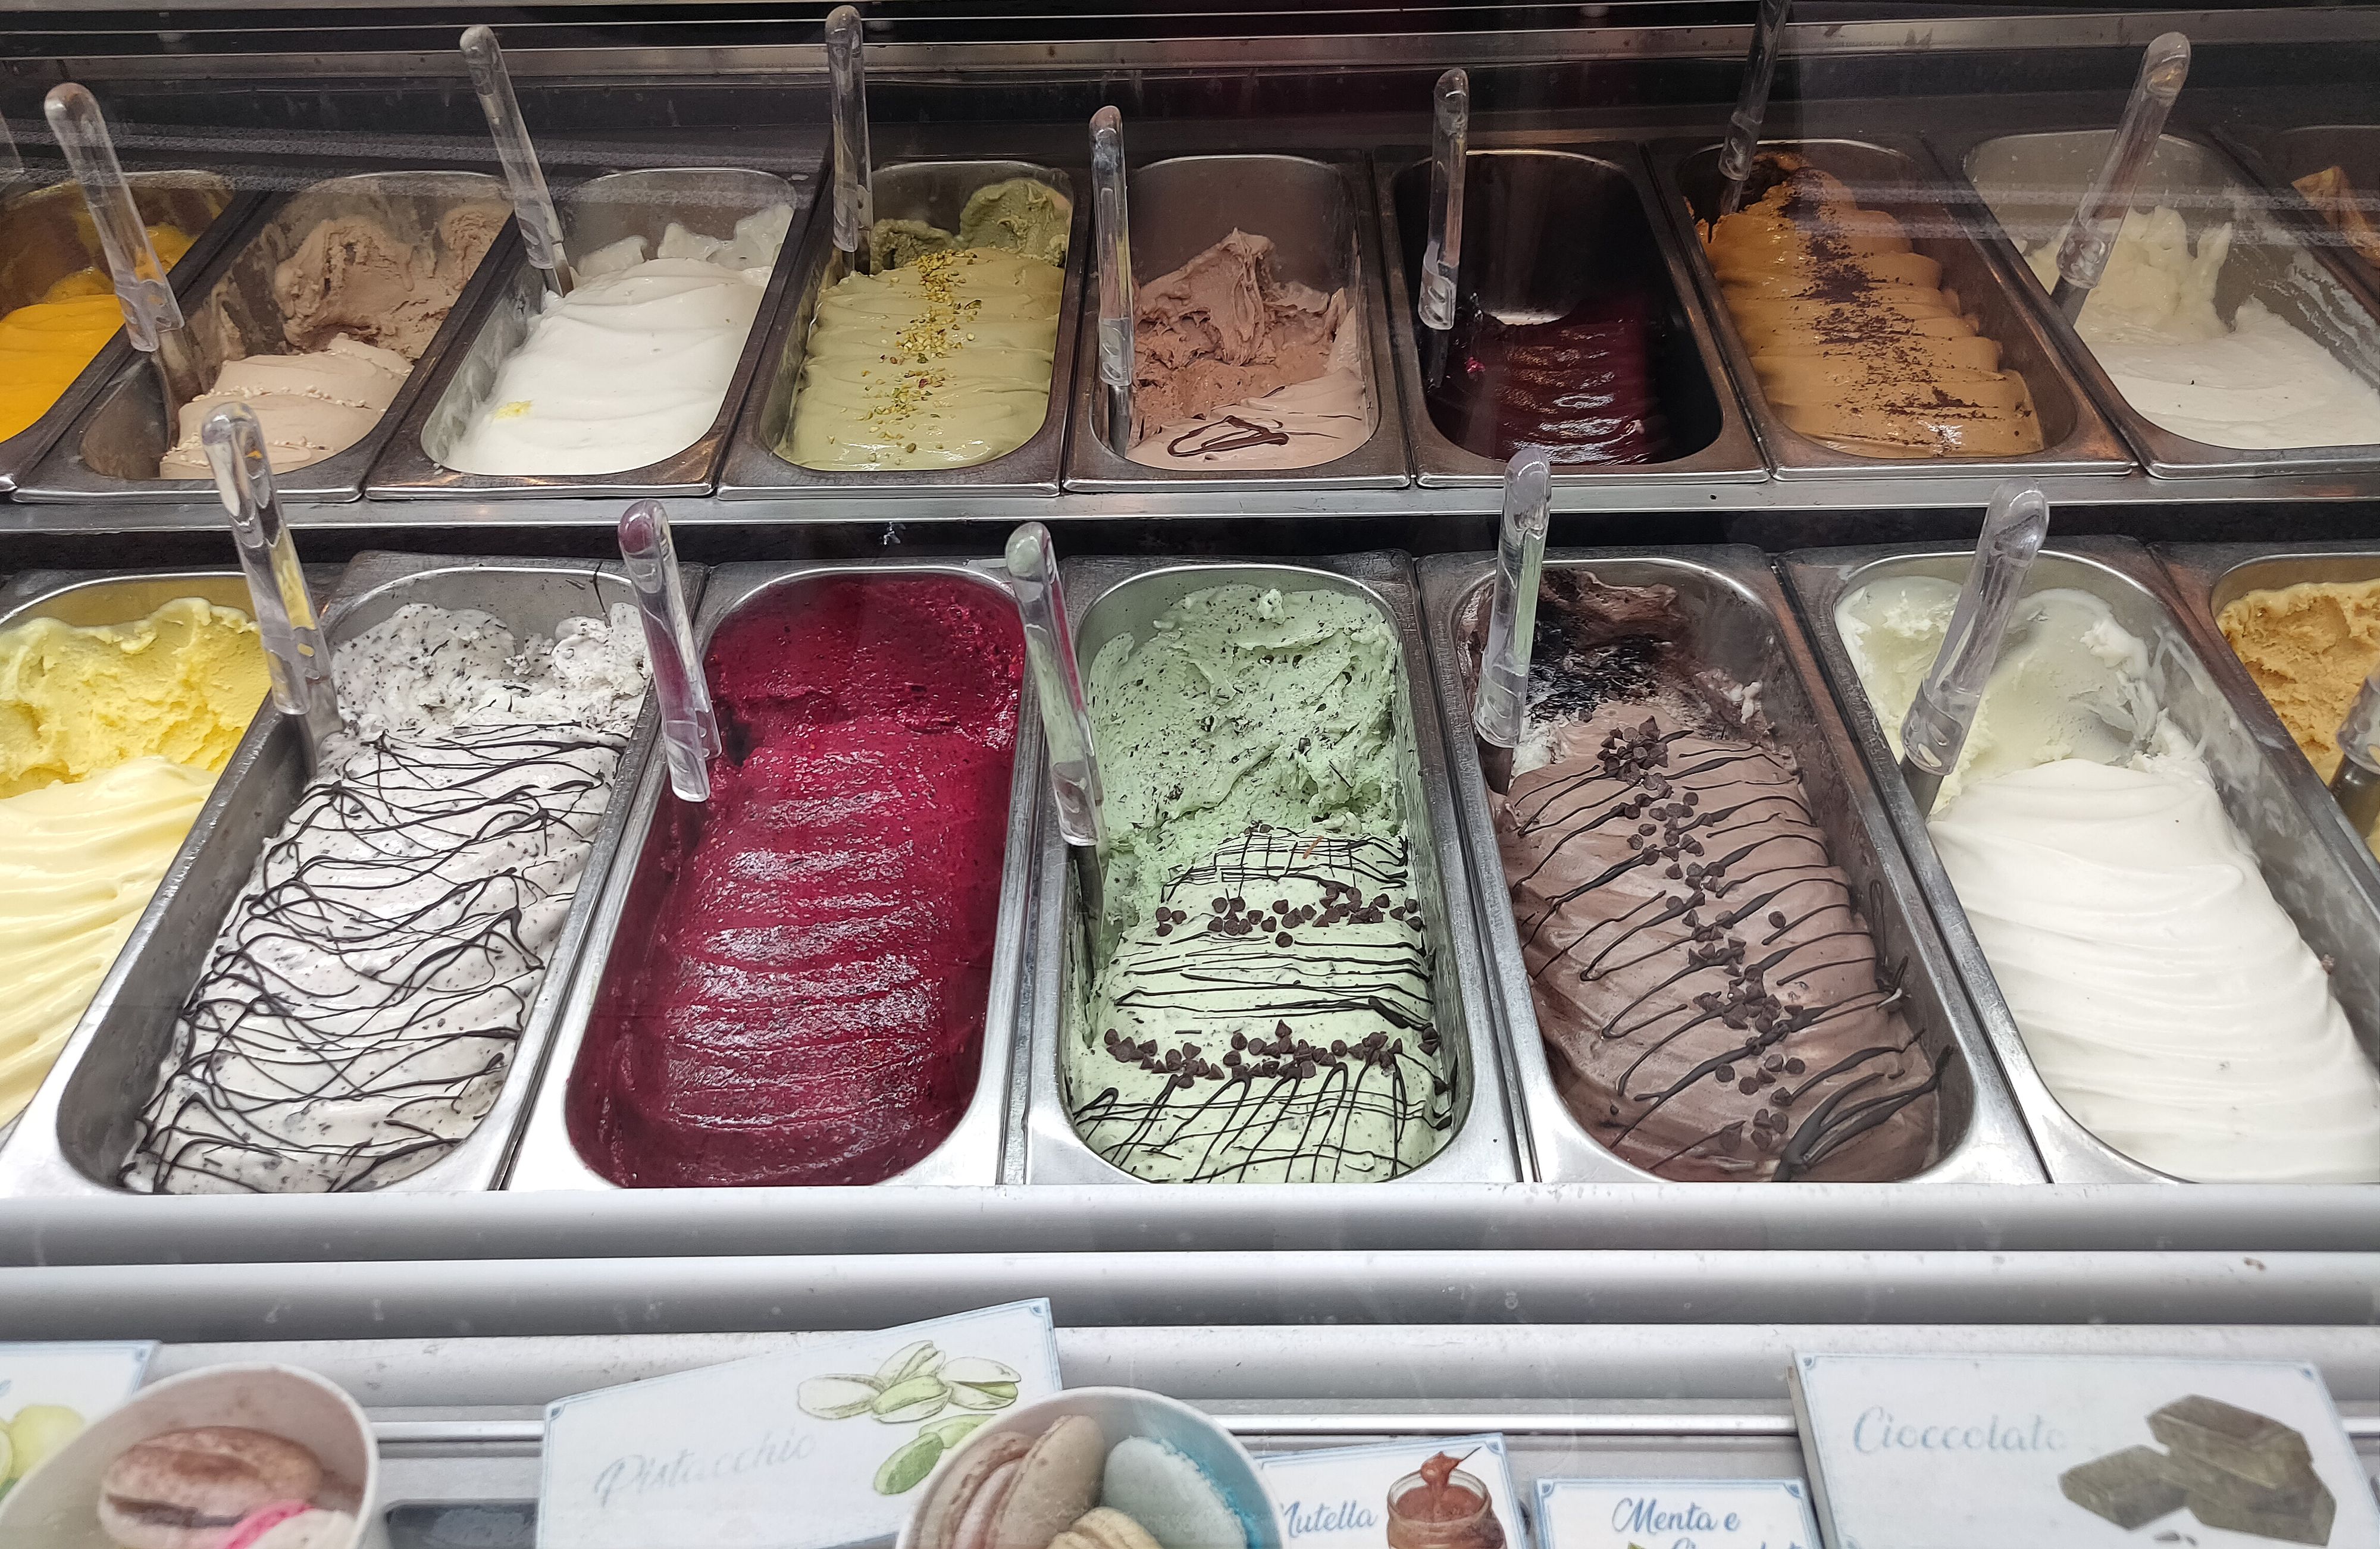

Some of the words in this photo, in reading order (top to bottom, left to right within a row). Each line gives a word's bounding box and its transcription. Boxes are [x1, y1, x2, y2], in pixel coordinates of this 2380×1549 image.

[1853, 1405, 2068, 1456] Cioccolato
[592, 1423, 816, 1507] Pistacchio
[1611, 1497, 1718, 1535] Menta
[1724, 1512, 1742, 1531] e
